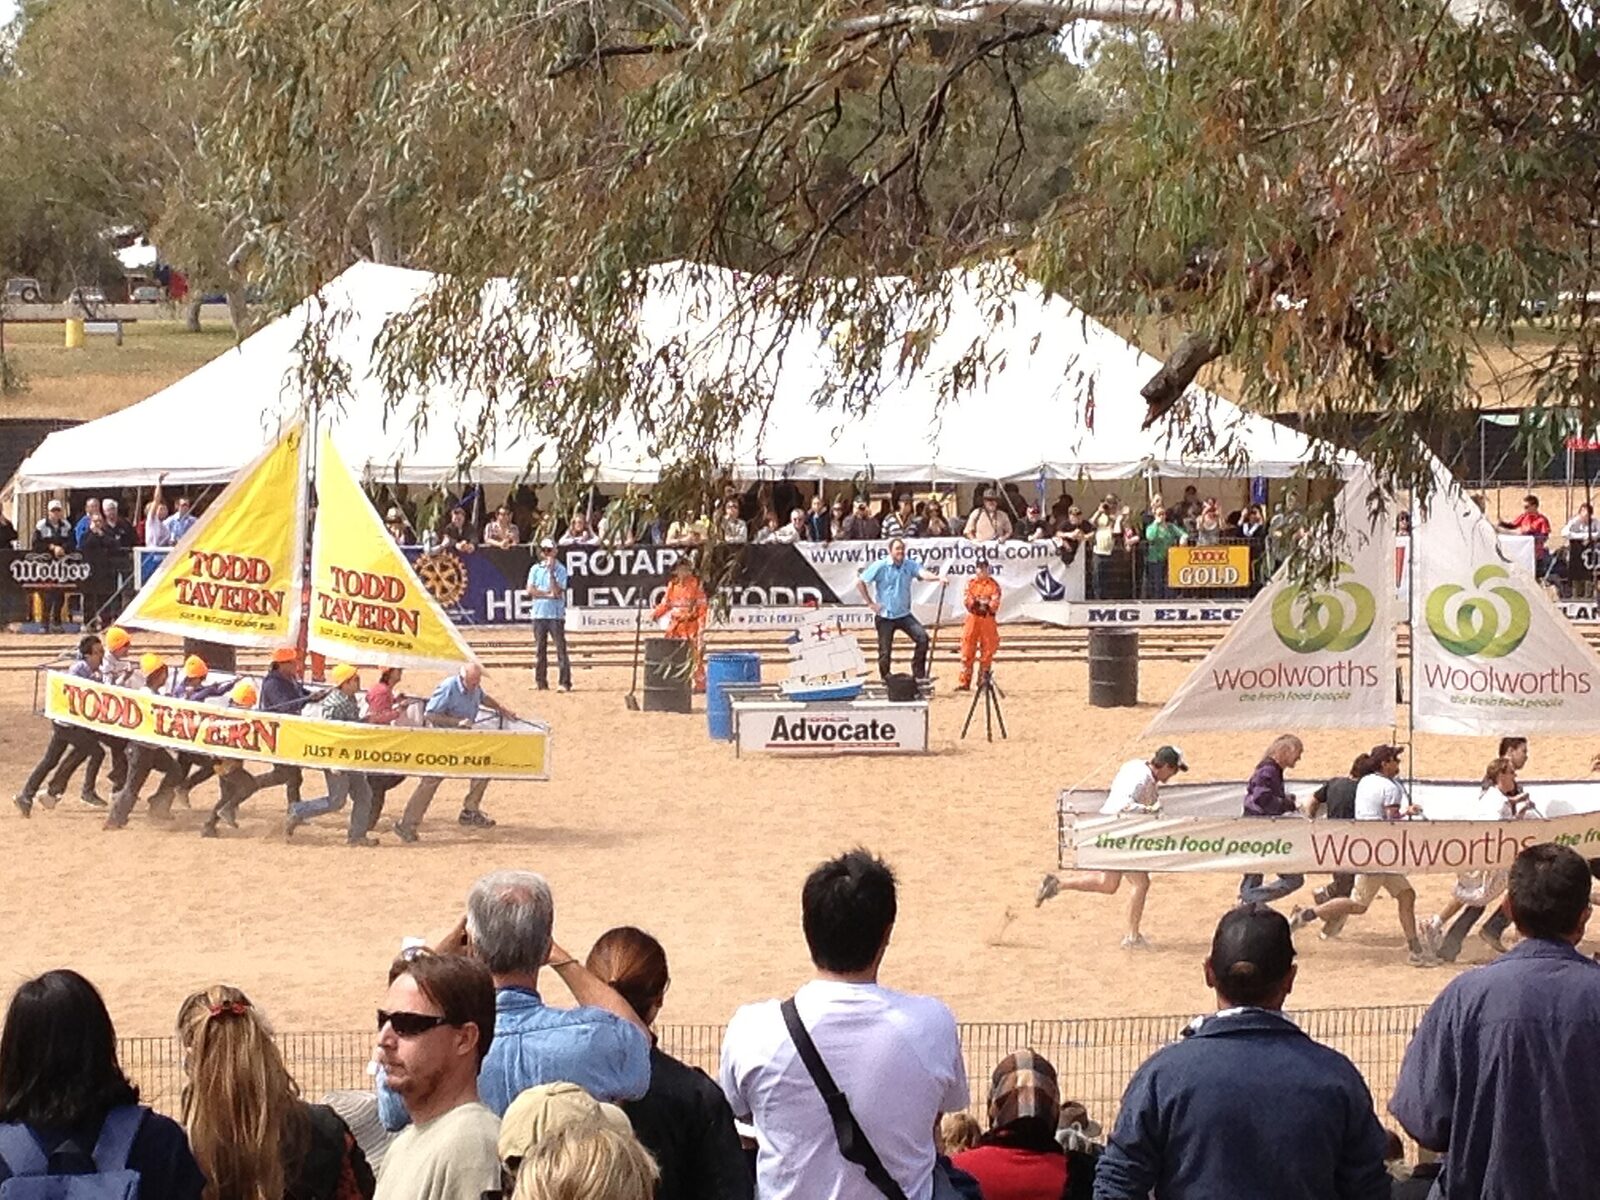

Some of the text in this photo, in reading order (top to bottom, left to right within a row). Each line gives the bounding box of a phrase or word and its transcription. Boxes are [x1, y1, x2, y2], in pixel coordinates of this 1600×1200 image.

[189, 550, 271, 585] TODD
[811, 543, 1062, 562] www.heeyontodd.com.a
[330, 565, 406, 603] TODD
[947, 563, 1003, 576] AUGT
[1178, 566, 1239, 586] GOLD
[174, 578, 285, 617] TAVERN
[318, 592, 420, 638] TAVERN
[1088, 608, 1141, 622] MG
[1213, 660, 1378, 691] Woolworths
[1424, 664, 1592, 694] Woolworths
[63, 684, 280, 754] TODD TAVERN
[771, 715, 896, 741] Advocate
[303, 745, 335, 758] JUST
[339, 748, 350, 759] A
[354, 749, 412, 764] BLOODY
[416, 752, 459, 767] GOOD
[1095, 833, 1293, 857] the fresh food people
[1311, 828, 1537, 867] Woolworths
